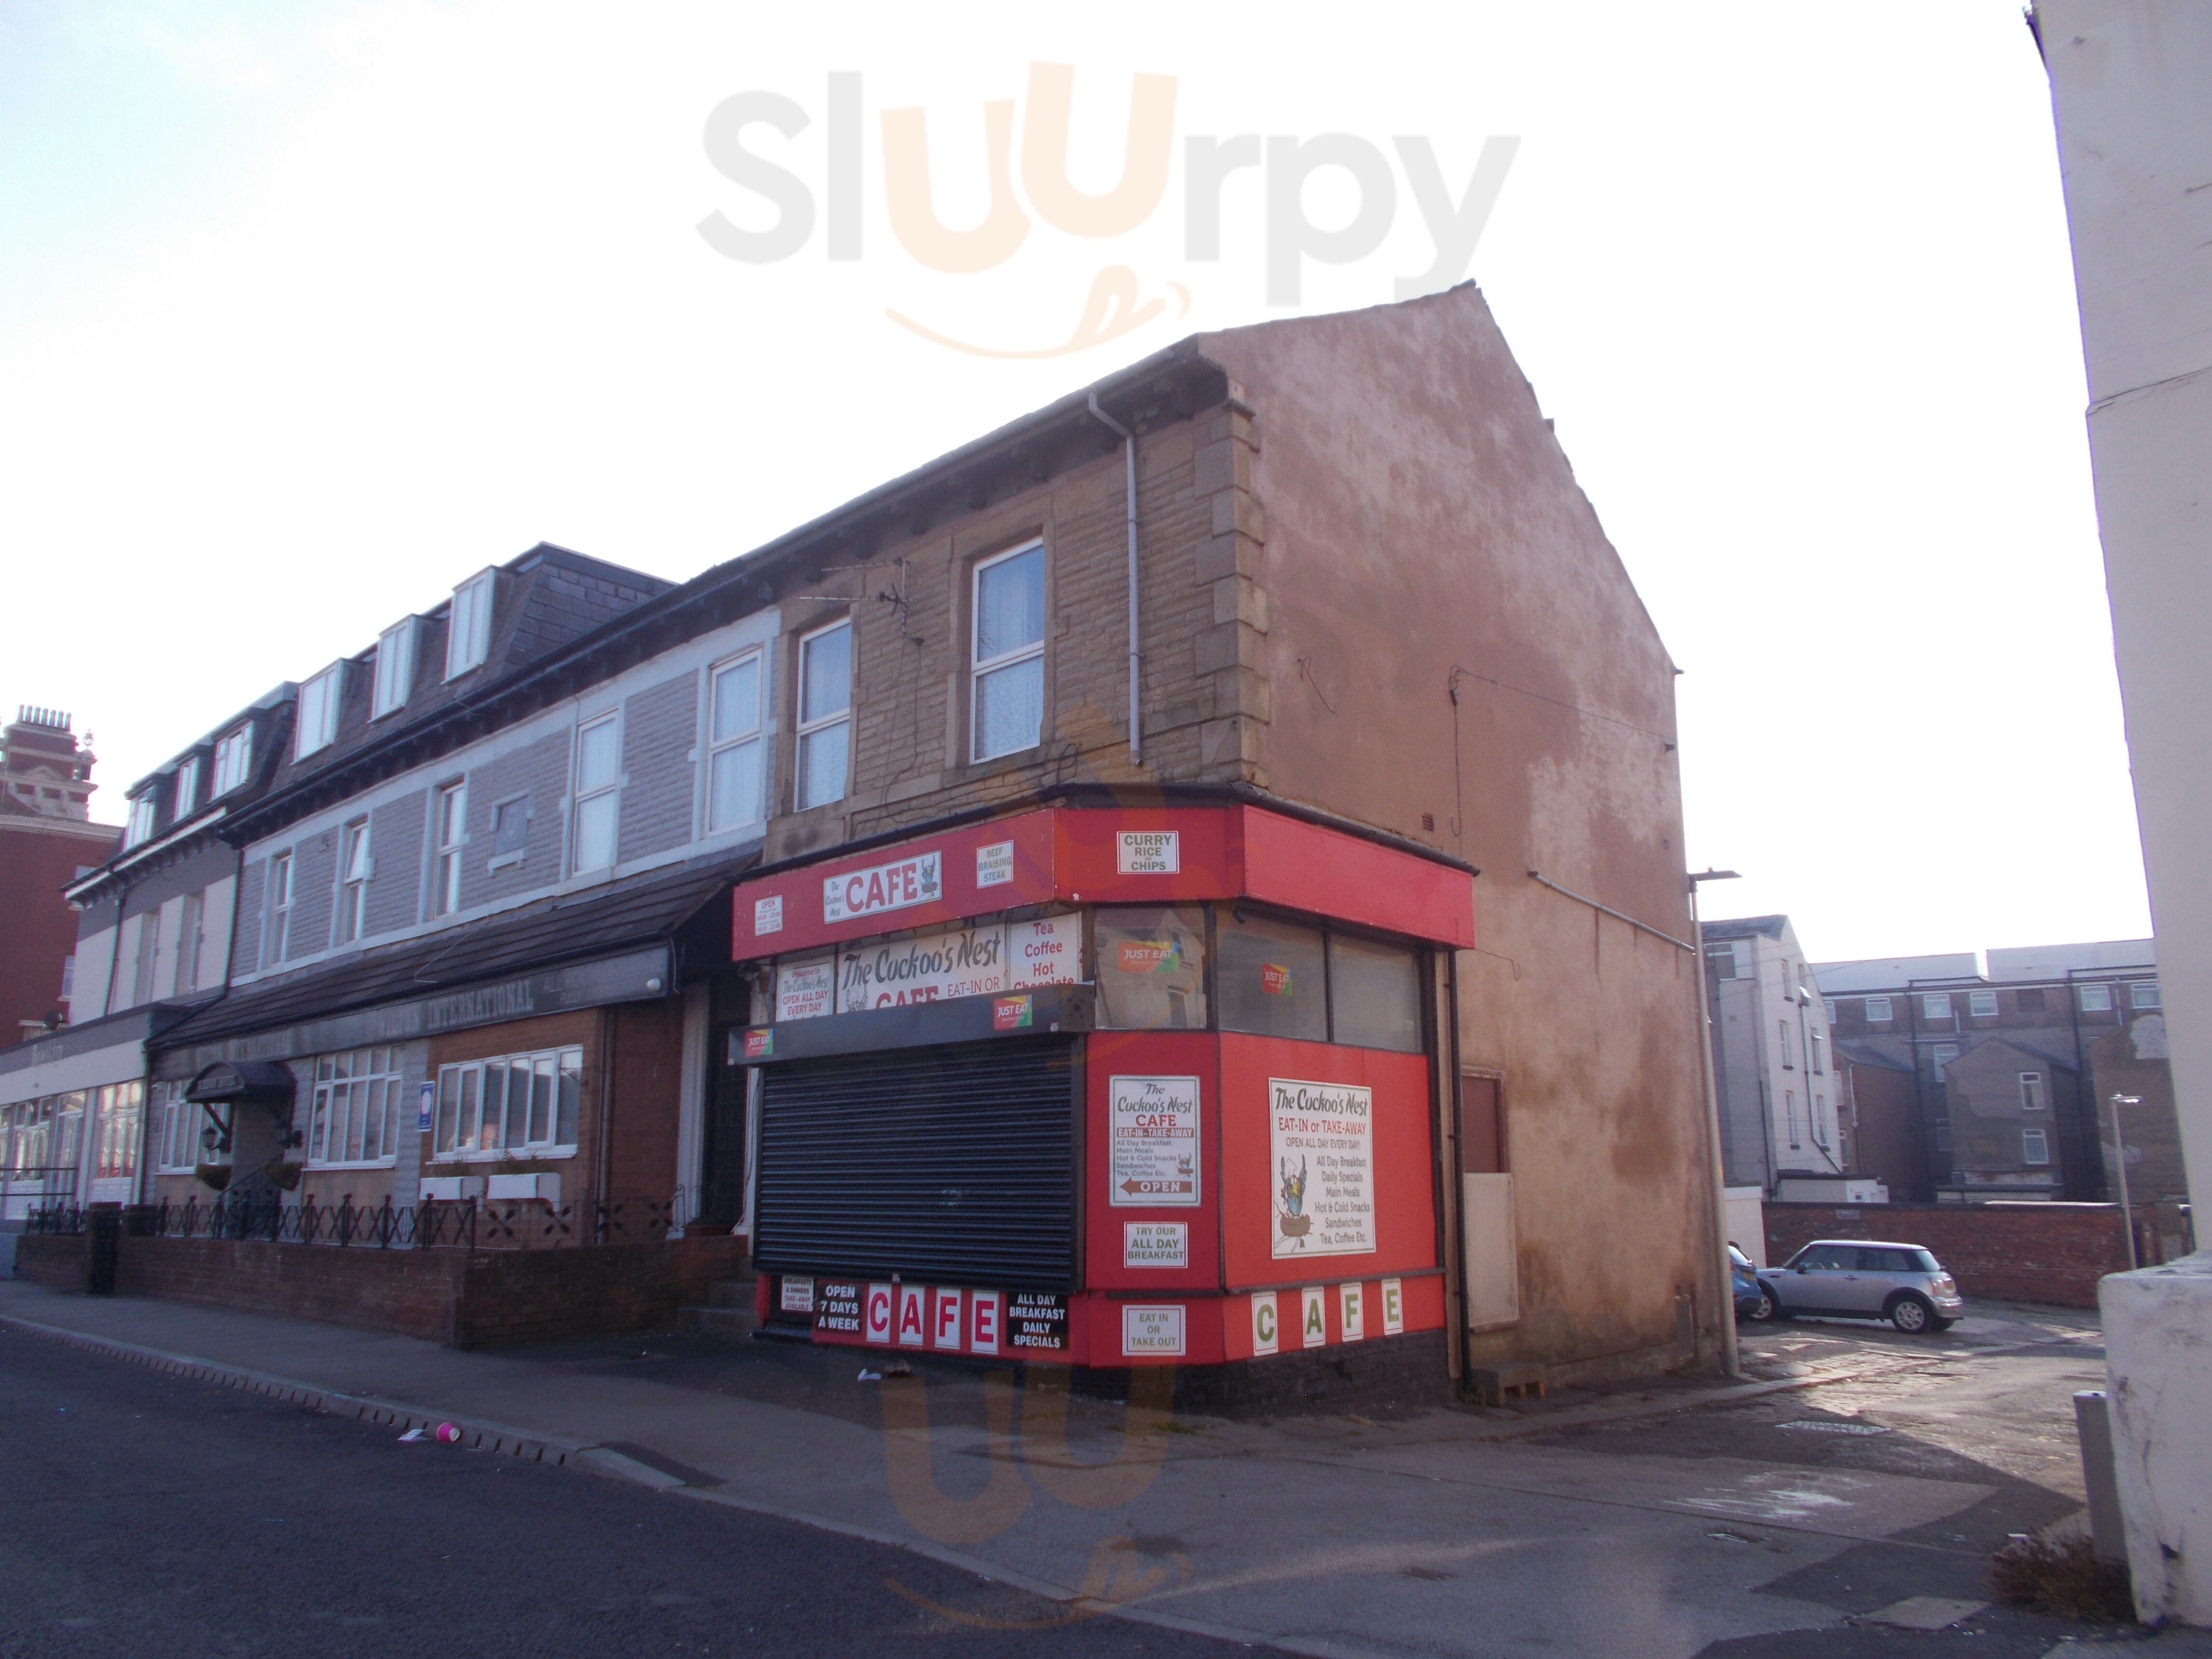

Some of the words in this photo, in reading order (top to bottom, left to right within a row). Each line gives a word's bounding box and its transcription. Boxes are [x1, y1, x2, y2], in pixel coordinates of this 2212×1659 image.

[1124, 835, 1172, 845] CURRY
[987, 847, 1003, 857] BEEF
[1134, 847, 1161, 856] RICE
[979, 856, 1011, 871] BRAISING
[1131, 861, 1166, 870] CHIPS
[984, 869, 1006, 882] STEAK
[831, 882, 839, 892] The
[846, 862, 918, 912] CAFE
[762, 899, 776, 909] OPEN
[1033, 922, 1054, 936] Tea
[1024, 941, 1063, 958] Coffee
[1124, 950, 1150, 960] JUST
[1153, 950, 1172, 959] EAT
[843, 952, 872, 990] The
[875, 938, 954, 983] Cuckoo's
[957, 930, 1001, 968] Nest
[792, 969, 814, 979] Welcome
[1033, 962, 1054, 977] Hot
[1265, 971, 1278, 981] JUST
[816, 975, 829, 989] Nest
[948, 979, 982, 997] EAT-IN
[985, 977, 1000, 991] OR
[783, 994, 800, 1005] OPEN
[802, 992, 813, 1002] ALL
[815, 990, 829, 1000] DAY
[788, 1004, 807, 1015] EVERY
[809, 1002, 822, 1012] DAY
[997, 1006, 1014, 1017] JUST
[1015, 1004, 1028, 1014] EAT
[749, 1036, 761, 1047] JUST
[761, 1035, 770, 1044] EAT
[1146, 1083, 1165, 1095] The
[1118, 1096, 1165, 1113] Cuckoo's
[1167, 1096, 1193, 1113] Nest
[1275, 1087, 1295, 1110] The
[1297, 1088, 1344, 1115] Cuckoo's
[1346, 1092, 1368, 1116] Nest
[1135, 1114, 1176, 1127] CAFE
[1278, 1117, 1308, 1132] EAT-IN
[1311, 1123, 1320, 1133] or
[1321, 1119, 1366, 1135] TAKE-AWAY
[1286, 1137, 1303, 1147] OPEN
[1305, 1138, 1316, 1148] ALL
[1318, 1138, 1329, 1148] DAY
[1330, 1139, 1348, 1149] EVERY
[1349, 1140, 1361, 1149] DAY!
[1317, 1156, 1325, 1166] All
[1327, 1156, 1339, 1169] Day
[1340, 1156, 1366, 1167] Breakfast
[1322, 1171, 1338, 1184] Daily
[1339, 1171, 1363, 1184] Specials
[1140, 1181, 1180, 1192] OPEN
[1326, 1186, 1341, 1197] Main
[1343, 1186, 1360, 1197] Meals
[1315, 1202, 1326, 1212] Hot
[1328, 1202, 1333, 1212] &
[1335, 1202, 1349, 1212] Cold
[1351, 1201, 1370, 1212] Snacks
[1325, 1217, 1362, 1228] Sandwiches
[1156, 1227, 1176, 1235] OUR
[1132, 1238, 1153, 1248] ALL
[1157, 1238, 1179, 1248] DAY
[1320, 1233, 1333, 1245] Tea,
[1335, 1232, 1354, 1243] Coffee
[1356, 1232, 1366, 1242] Etc.
[826, 1285, 855, 1298] OPEN
[1017, 1293, 1035, 1305] ALL
[1037, 1294, 1056, 1305] DAY
[821, 1301, 827, 1312] 7
[830, 1301, 859, 1315] DAYS
[1010, 1306, 1065, 1319] BREAKFAST
[818, 1316, 826, 1328] A
[828, 1317, 860, 1331] WEEK
[1139, 1314, 1156, 1322] EAT
[1159, 1314, 1168, 1322] IN
[1023, 1321, 1051, 1333] DAILY
[1147, 1325, 1161, 1334] OR
[1014, 1334, 1060, 1348] SPECIALS
[1132, 1337, 1155, 1346] TAKE
[1158, 1337, 1176, 1346] OUT
